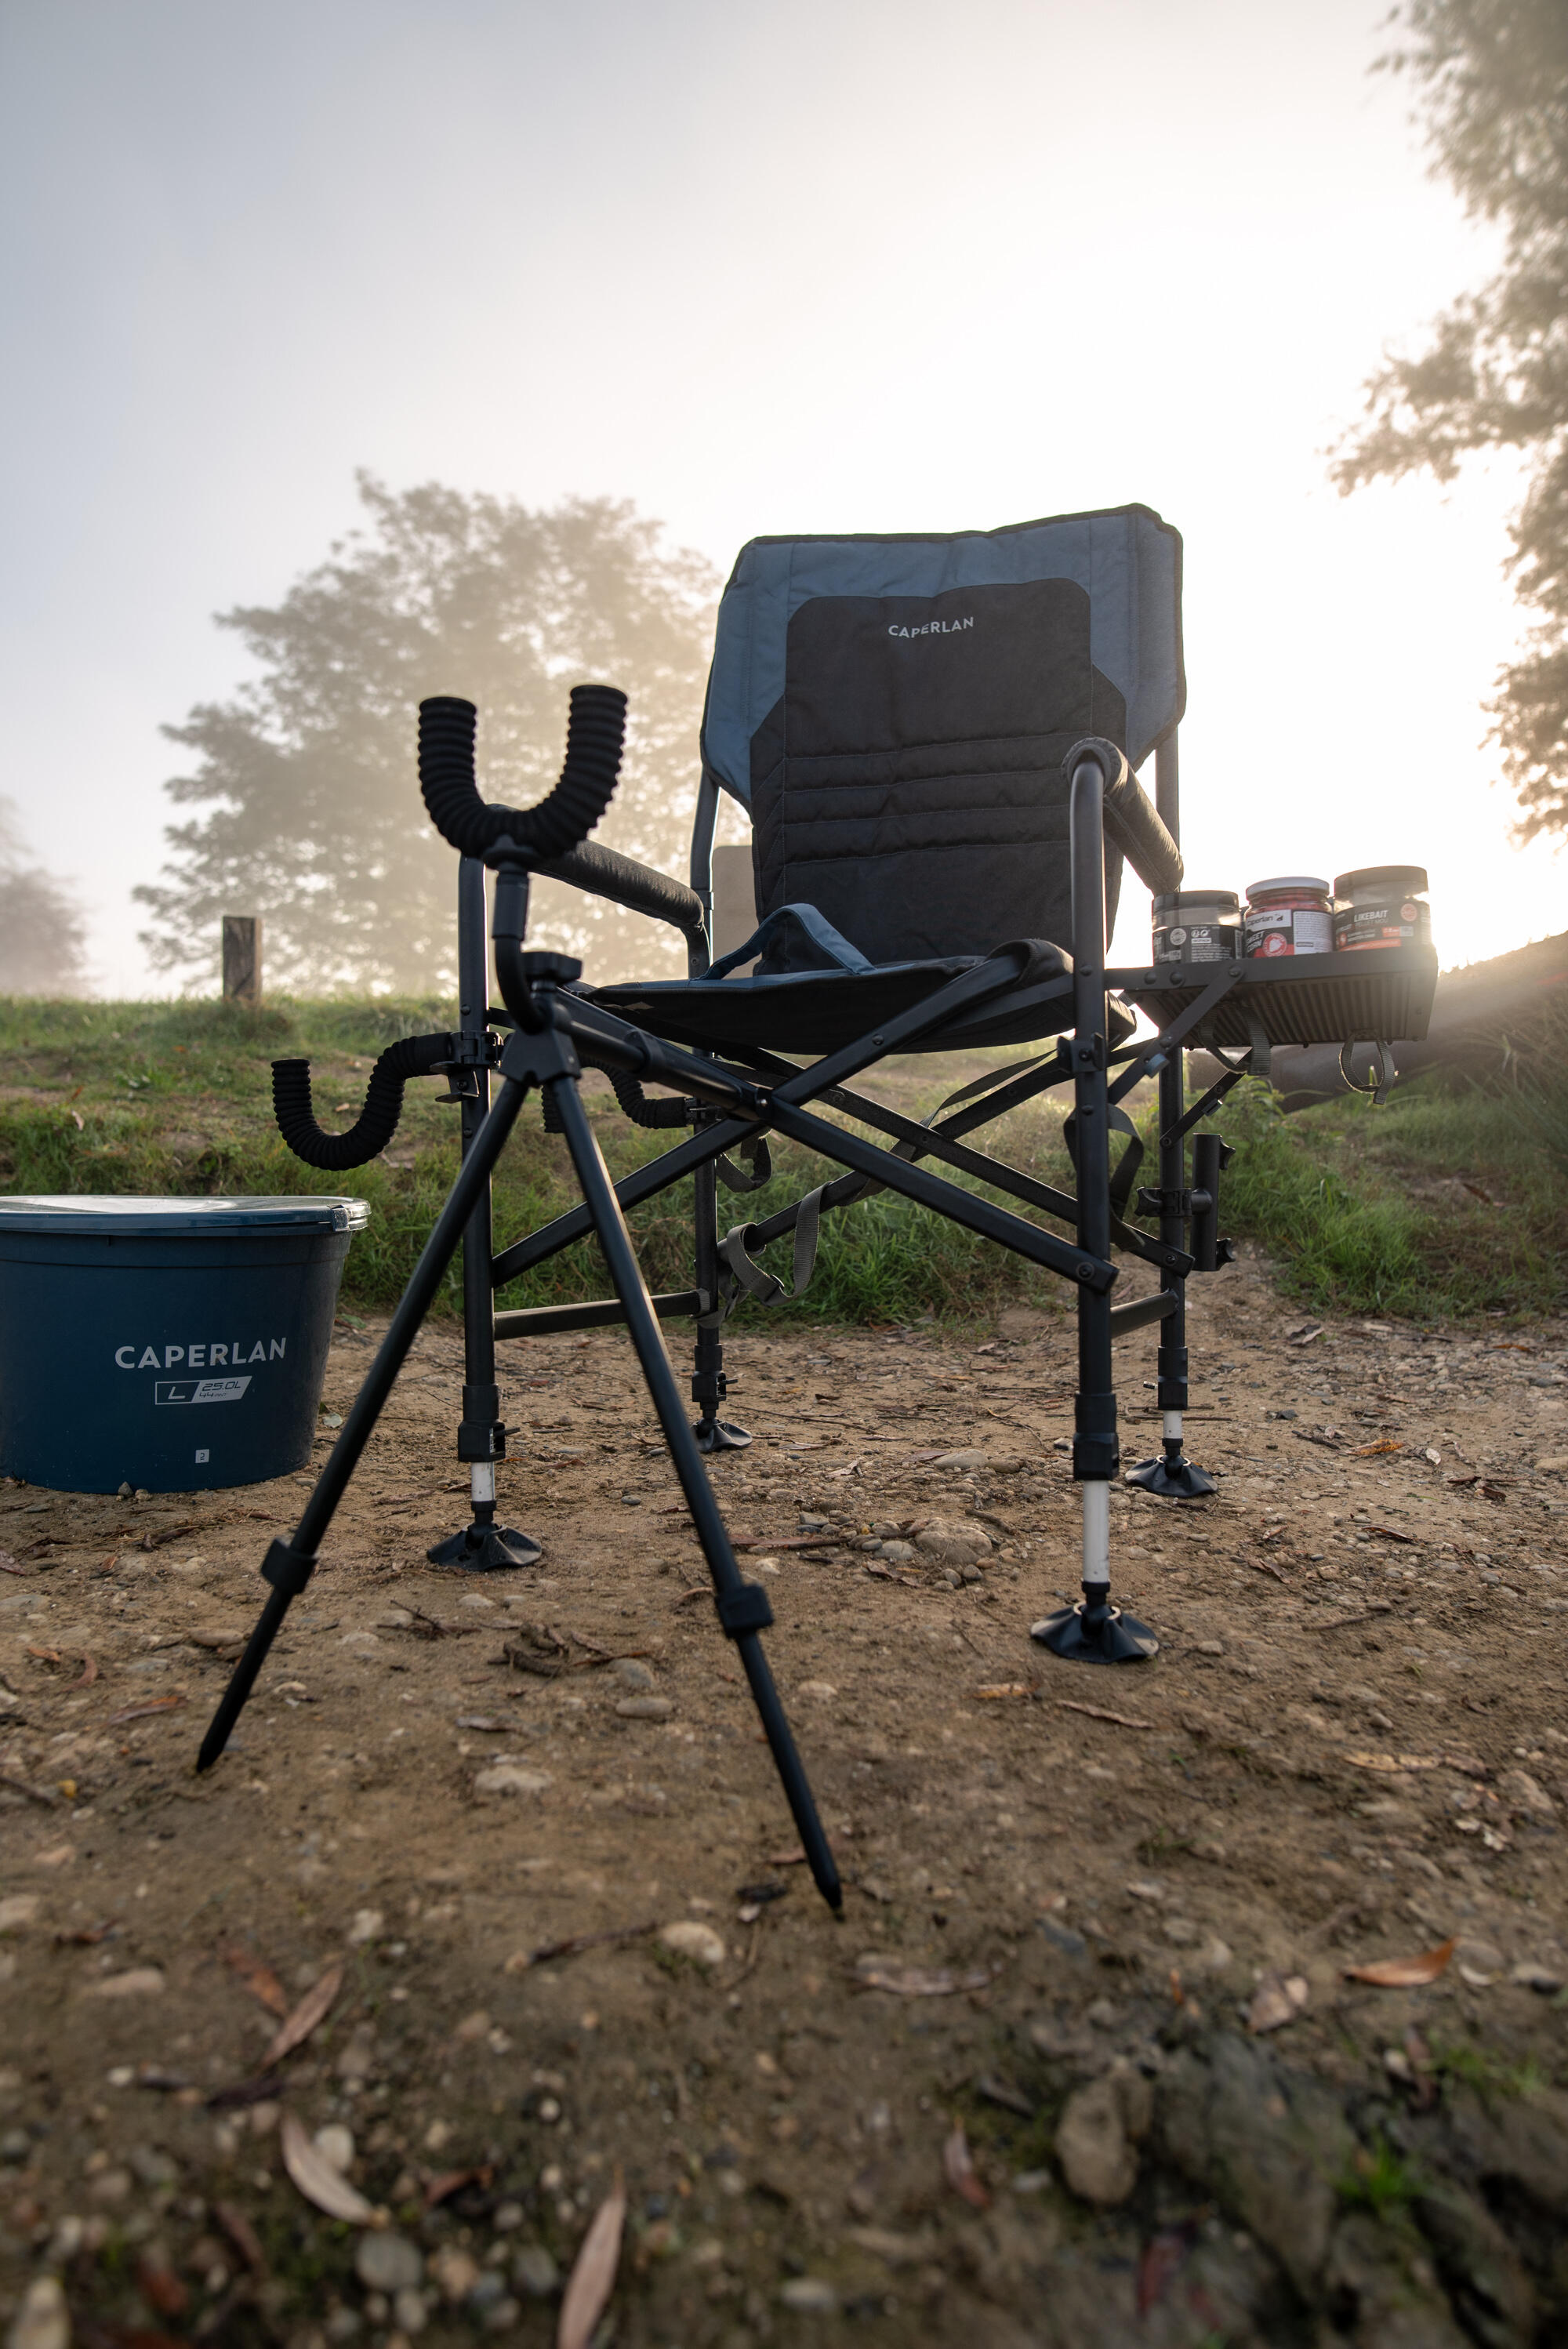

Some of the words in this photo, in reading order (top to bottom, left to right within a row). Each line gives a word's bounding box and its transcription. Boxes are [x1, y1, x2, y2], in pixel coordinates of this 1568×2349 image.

[887, 616, 974, 638] CAPERLAN
[1354, 909, 1388, 922] LIKEBAIT
[114, 1337, 287, 1369] CAPERLAN
[169, 1386, 186, 1399] L
[201, 1381, 241, 1392] 25.0L
